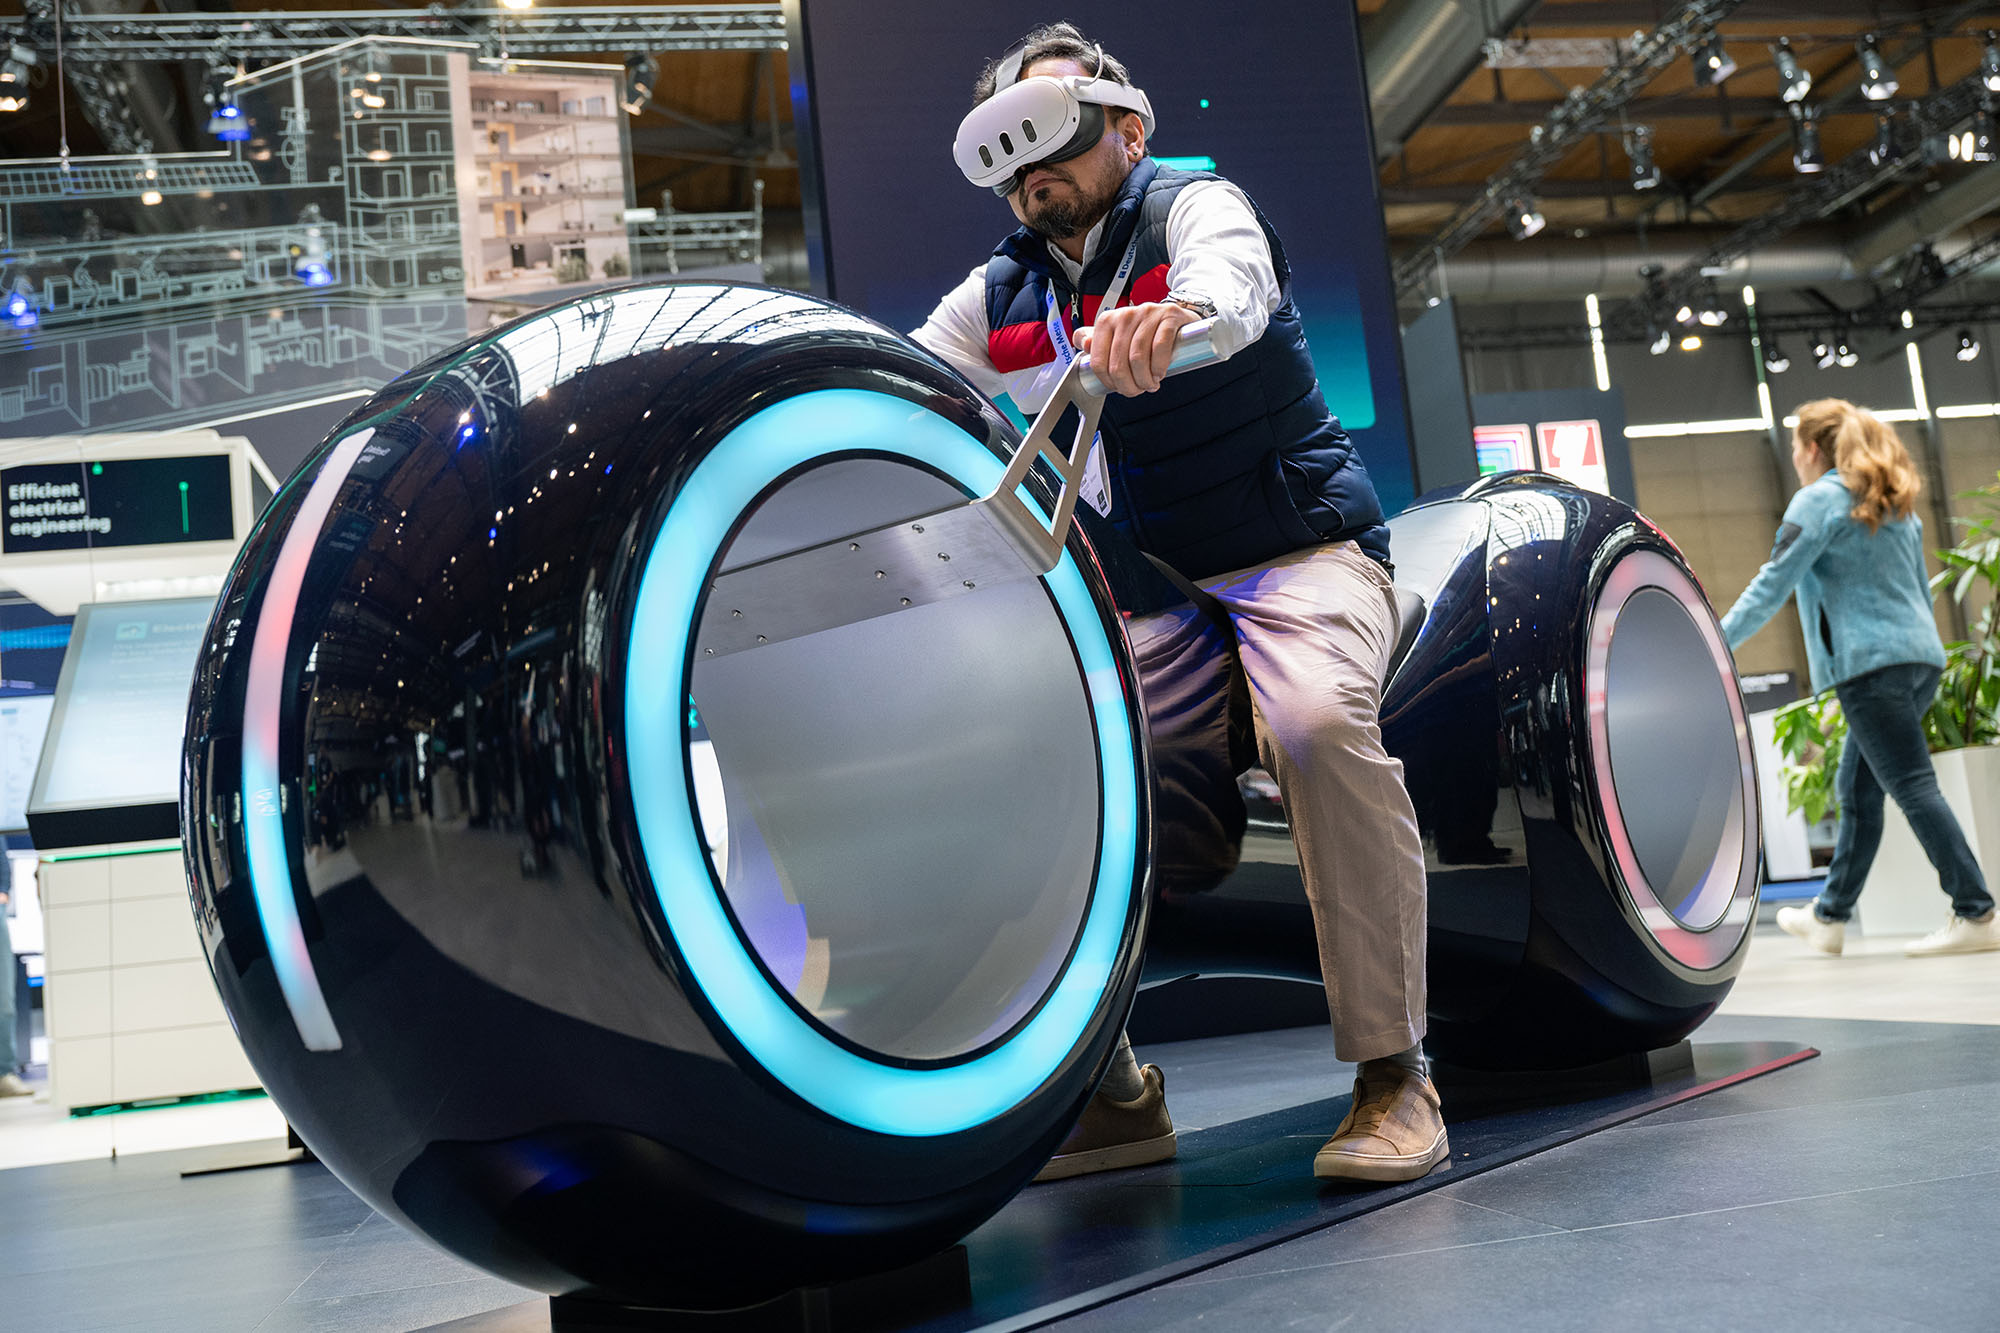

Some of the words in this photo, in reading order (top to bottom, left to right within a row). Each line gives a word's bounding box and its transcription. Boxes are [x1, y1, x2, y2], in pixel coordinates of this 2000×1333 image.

[1053, 321, 1065, 344] Messe
[9, 482, 80, 500] Efficient
[9, 498, 86, 518] electrical
[10, 515, 111, 537] engineering
